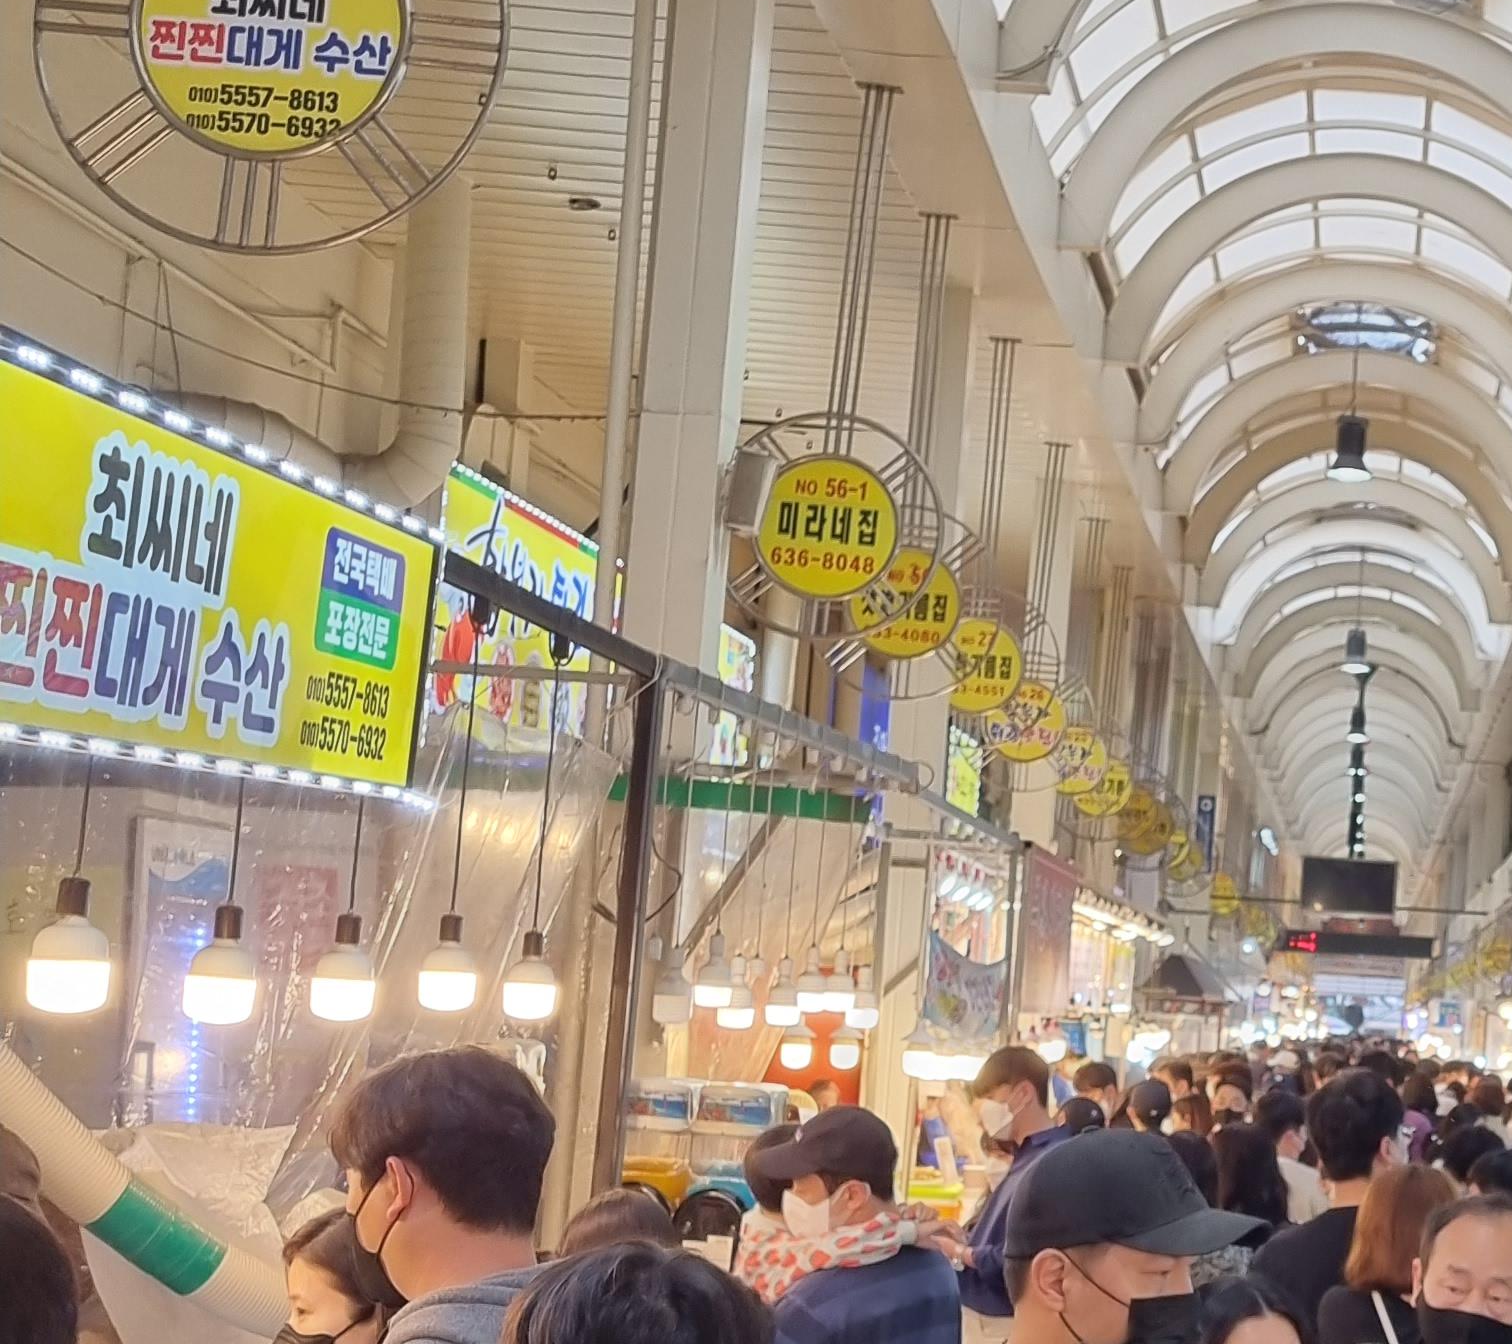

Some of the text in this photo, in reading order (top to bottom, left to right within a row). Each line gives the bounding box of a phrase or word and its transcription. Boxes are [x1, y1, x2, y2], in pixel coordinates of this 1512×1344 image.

[150, 20, 391, 76] 찐찐대게 수산
[188, 84, 338, 113] 010)5557-8613
[796, 478, 868, 501] NO 56-1
[88, 446, 233, 596] 최씨네
[778, 502, 878, 547] 미라네집
[333, 538, 397, 600] 전국택배
[771, 547, 875, 574] 636-8048
[324, 600, 390, 660] 포장전문
[201, 621, 284, 733] 수산
[306, 672, 389, 719] 010)5557-8613
[300, 716, 387, 760] 010)5570-6932
